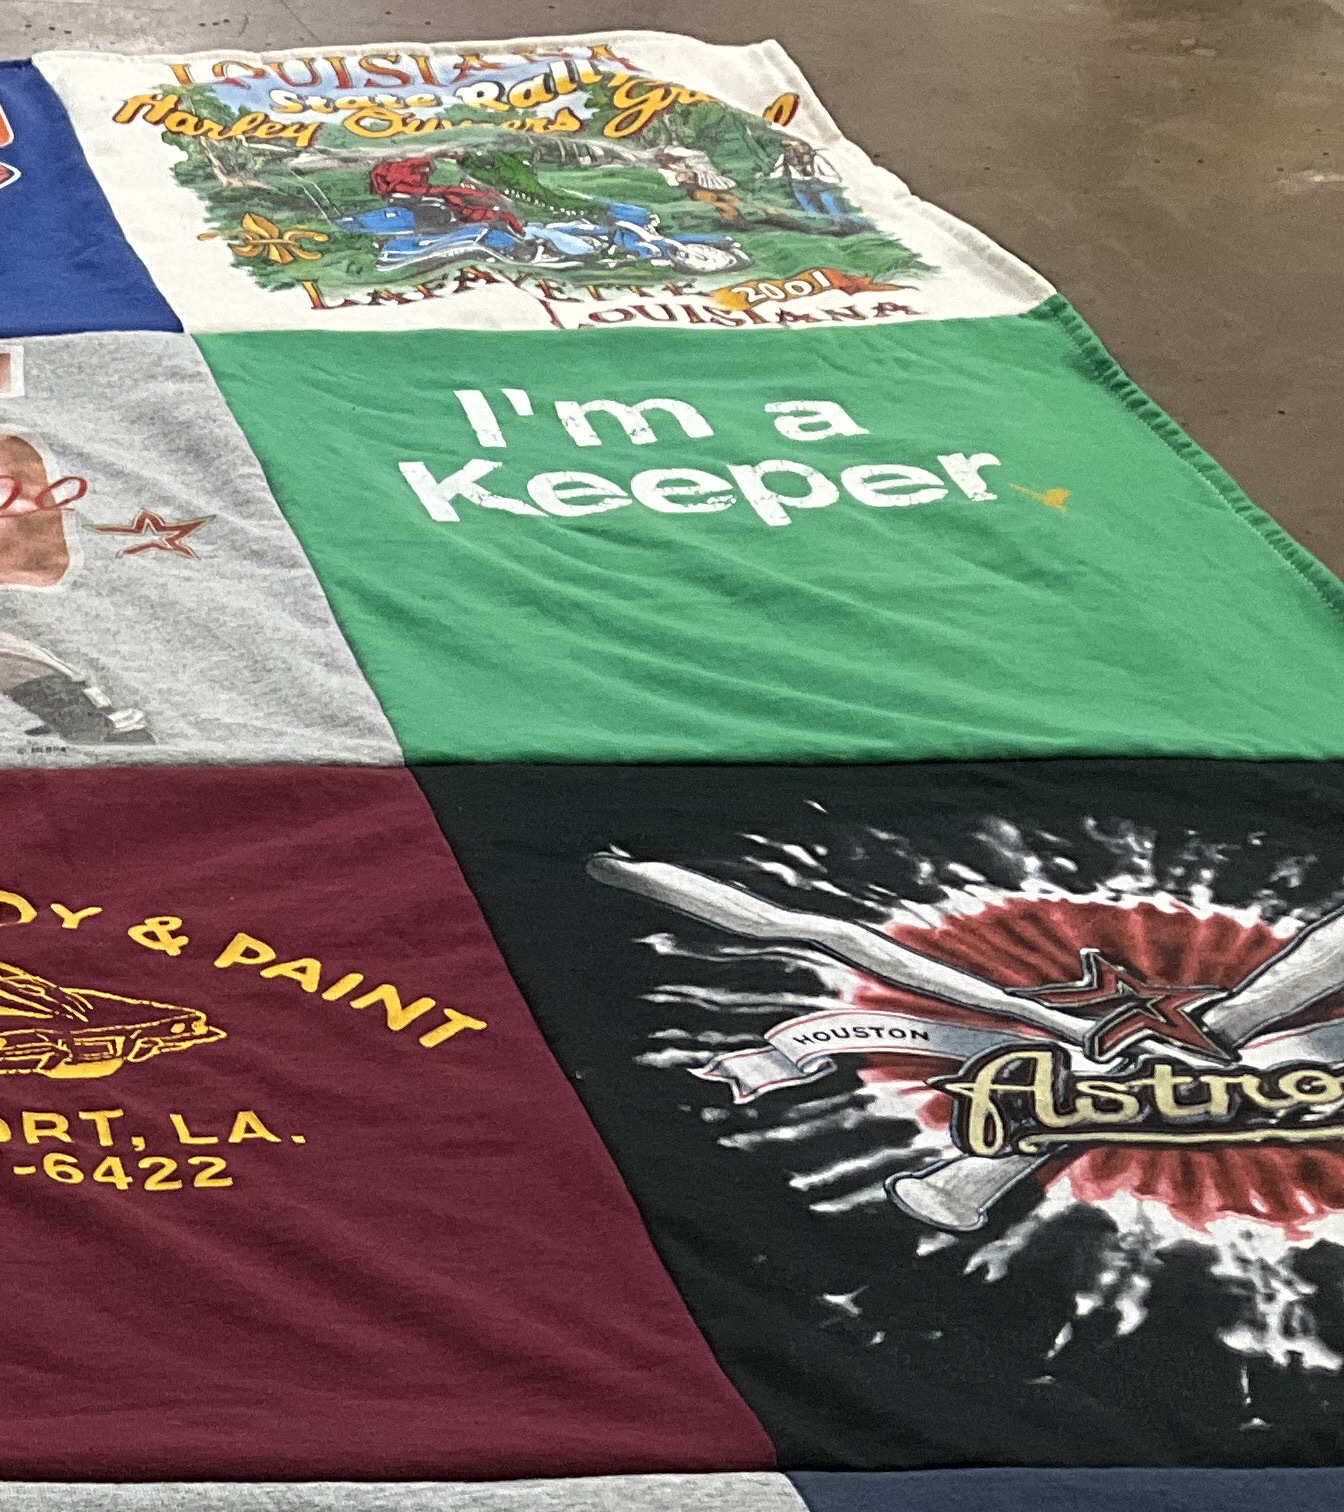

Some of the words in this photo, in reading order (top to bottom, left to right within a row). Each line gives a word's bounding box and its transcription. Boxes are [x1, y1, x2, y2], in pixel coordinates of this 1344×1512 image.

[113, 93, 321, 147] Harley
[730, 270, 832, 304] 2001
[453, 387, 714, 448] I'm
[763, 399, 871, 443] a
[398, 452, 1003, 526] Keeper
[127, 915, 190, 957] &
[214, 932, 488, 1049] PAINT
[792, 1023, 930, 1046] HOUSTON
[170, 1110, 307, 1145] LA.
